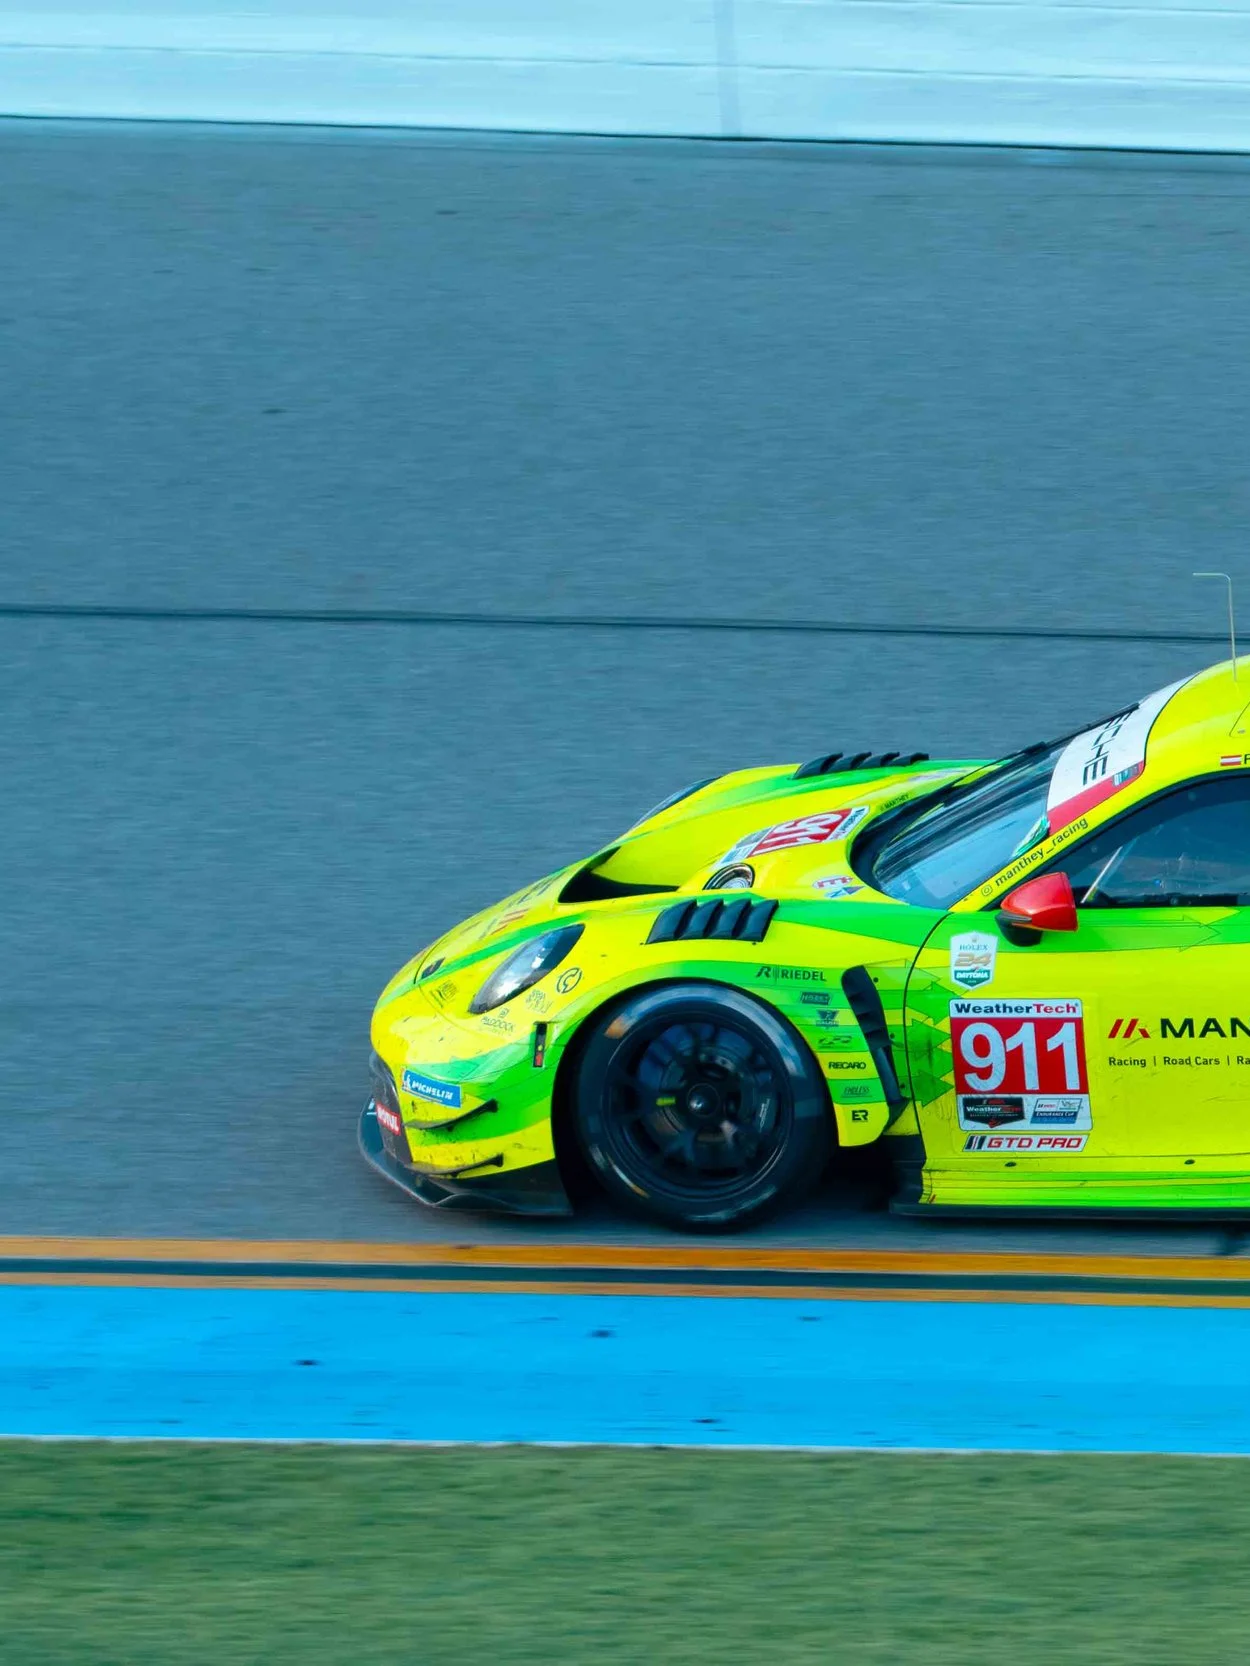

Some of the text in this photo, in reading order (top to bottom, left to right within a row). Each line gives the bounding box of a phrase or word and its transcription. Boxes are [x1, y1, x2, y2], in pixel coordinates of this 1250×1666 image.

[751, 813, 843, 857] 911
[994, 817, 1089, 887] manthey_racing
[954, 952, 992, 967] 24
[780, 969, 827, 982] RIEDEL
[956, 971, 989, 979] DAYTONA
[954, 1003, 1078, 1014] WeatherTech
[960, 1022, 1080, 1091] 911
[1108, 1056, 1147, 1068] Racing
[1163, 1056, 1191, 1066] Road
[1194, 1056, 1220, 1066] Cars
[828, 1061, 866, 1069] RECARO
[411, 1080, 454, 1100] MICHELIN
[851, 1109, 869, 1121] ER
[986, 1137, 1083, 1148] GTD PRO
